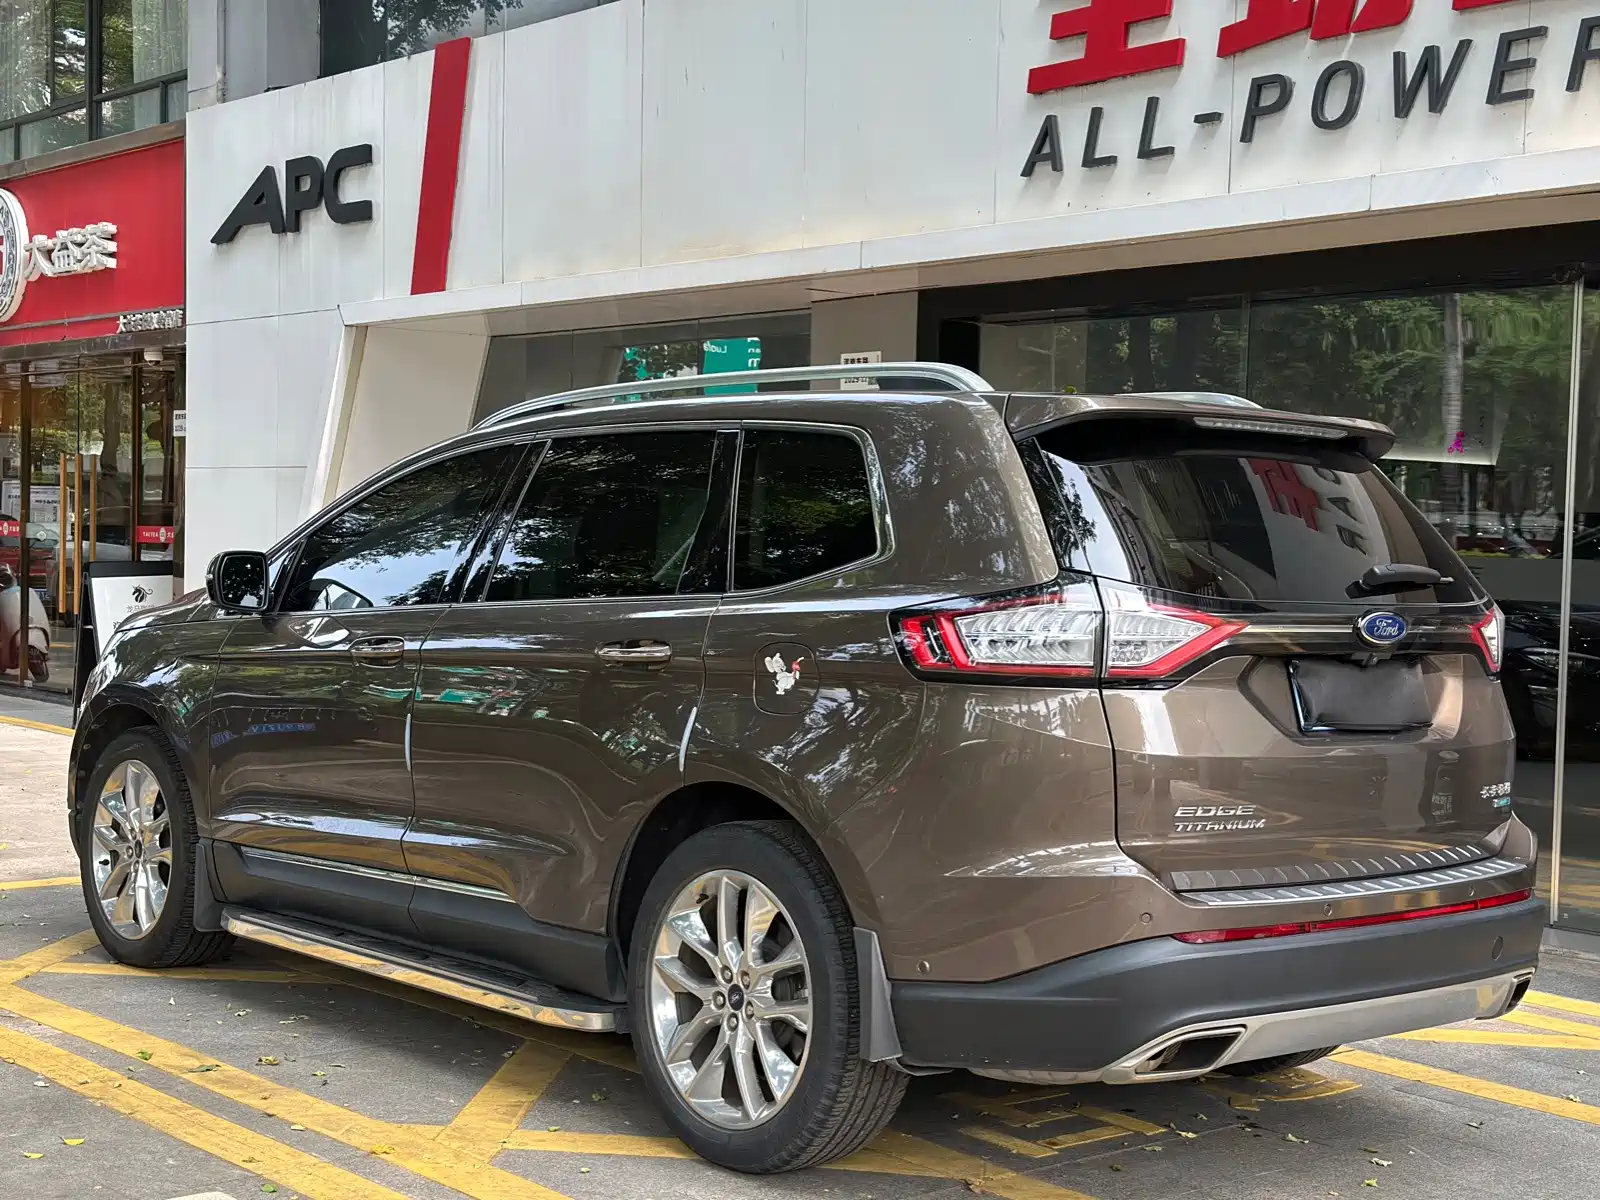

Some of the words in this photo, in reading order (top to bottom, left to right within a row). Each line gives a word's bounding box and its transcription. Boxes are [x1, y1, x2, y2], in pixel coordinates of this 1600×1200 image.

[210, 143, 373, 245] APC
[1373, 618, 1400, 637] Ford
[1174, 805, 1256, 818] EDGE
[1174, 819, 1267, 832] TITANIUM
